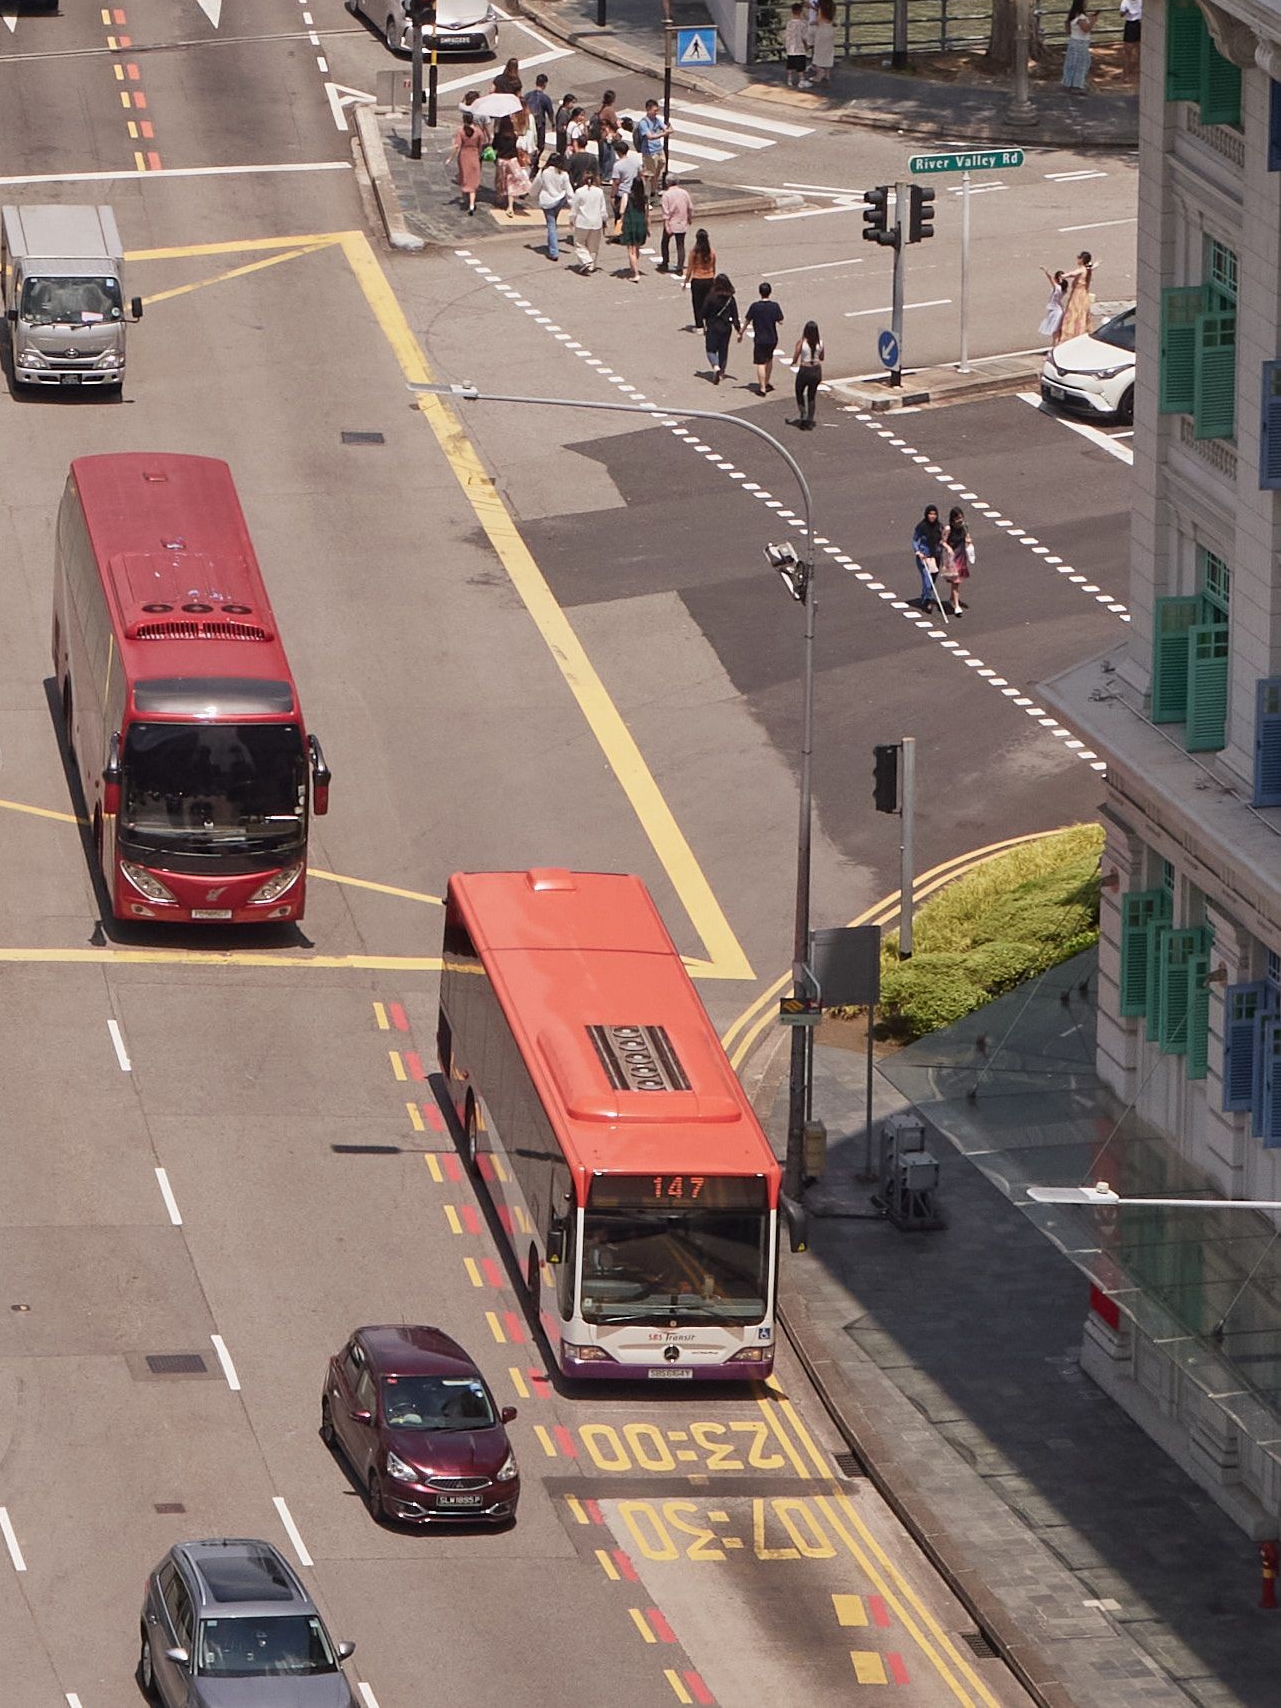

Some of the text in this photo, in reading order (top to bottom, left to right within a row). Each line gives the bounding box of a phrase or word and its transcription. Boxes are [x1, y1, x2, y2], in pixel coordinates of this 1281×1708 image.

[916, 152, 1018, 170] River Valley Rd
[653, 1176, 705, 1198] 147
[665, 1332, 696, 1342] Transit
[578, 1421, 786, 1472] 23:00
[617, 1498, 838, 1561] 07:30
